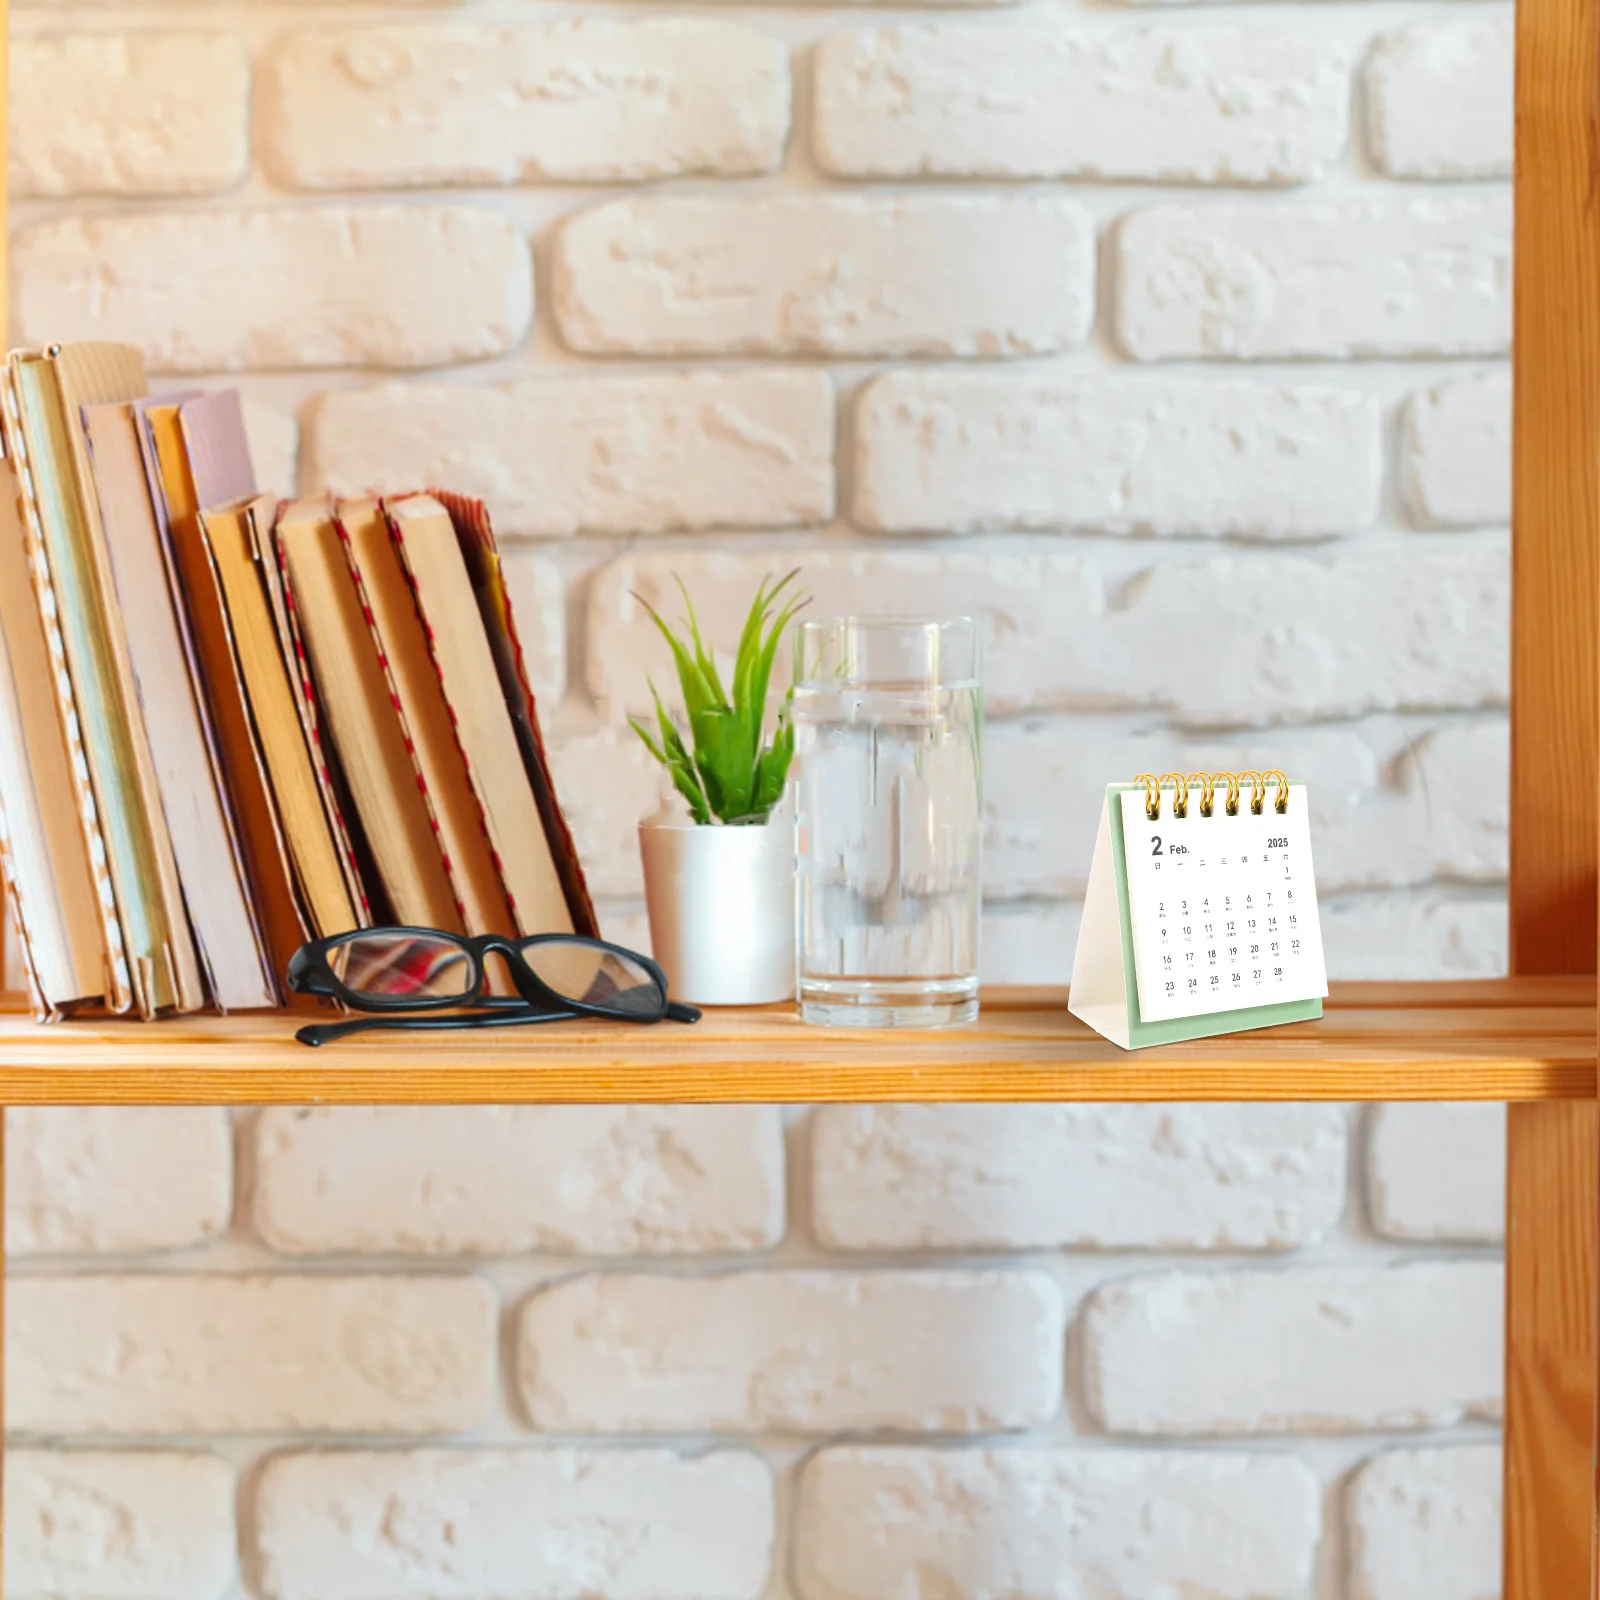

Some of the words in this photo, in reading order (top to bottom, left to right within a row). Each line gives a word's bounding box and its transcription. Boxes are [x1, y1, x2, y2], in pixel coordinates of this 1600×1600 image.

[1150, 835, 1164, 857] 2
[1169, 844, 1190, 855] Feb.
[1267, 837, 1289, 849] 2025
[1154, 862, 1161, 871] 日
[1199, 859, 1206, 867] 二
[1220, 857, 1228, 865] 三
[1241, 855, 1249, 864] 四
[1262, 854, 1269, 862] 五
[1282, 853, 1289, 861] 六
[1159, 902, 1165, 911] 2
[1181, 900, 1187, 909] 3
[1203, 898, 1209, 907] 4
[1225, 896, 1231, 905] 5
[1246, 894, 1252, 903] 6
[1266, 892, 1272, 901] 7
[1287, 890, 1293, 899] 8
[1161, 928, 1167, 938] 9
[1182, 926, 1192, 935] 10
[1204, 923, 1213, 933] 11
[1226, 921, 1235, 931] 12
[1247, 919, 1257, 928] 13
[1268, 916, 1277, 926] 14
[1288, 914, 1297, 924] 15
[1162, 955, 1172, 964] 16
[1185, 952, 1194, 961] 17
[1207, 949, 1217, 959] 18
[1229, 946, 1238, 956] 19
[1250, 944, 1260, 954] 20
[1270, 941, 1279, 951] 21
[1291, 939, 1300, 949] 22
[1164, 981, 1175, 991] 23
[1187, 978, 1198, 988] 24
[1209, 975, 1220, 985] 25
[1231, 972, 1241, 982] 26
[1252, 969, 1262, 979] 27
[1273, 967, 1283, 976] 28
